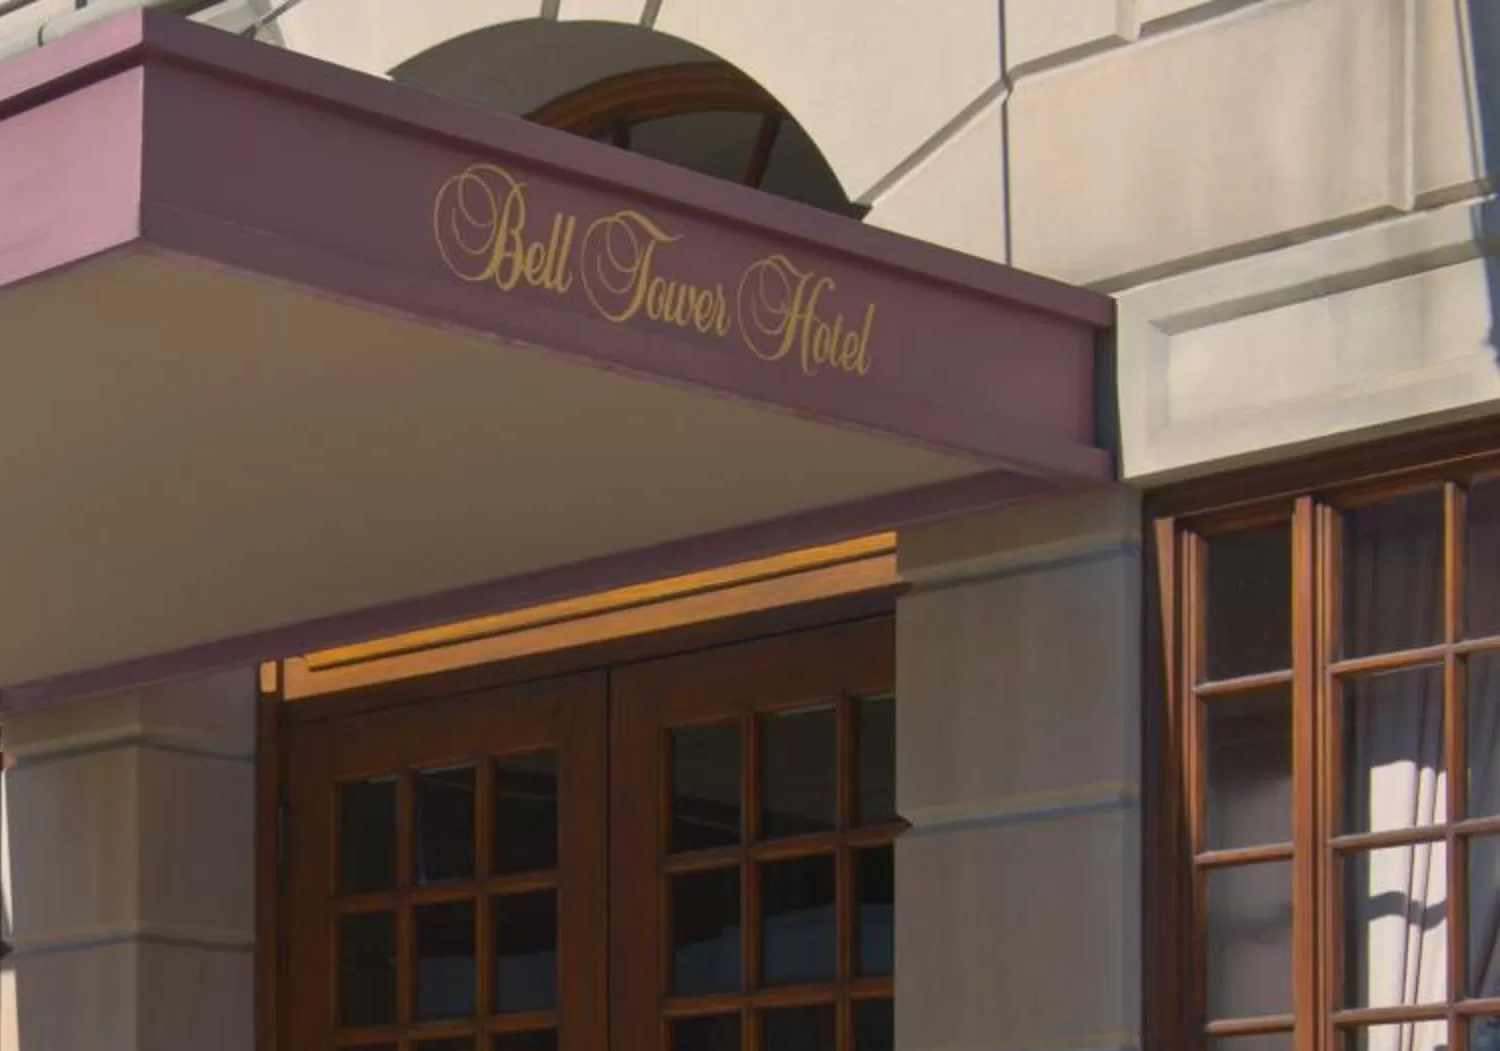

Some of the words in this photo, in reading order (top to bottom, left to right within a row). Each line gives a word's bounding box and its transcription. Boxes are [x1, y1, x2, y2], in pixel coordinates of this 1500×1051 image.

[434, 163, 574, 292] Bell
[580, 209, 732, 337] Tower
[737, 254, 877, 377] Hotel
